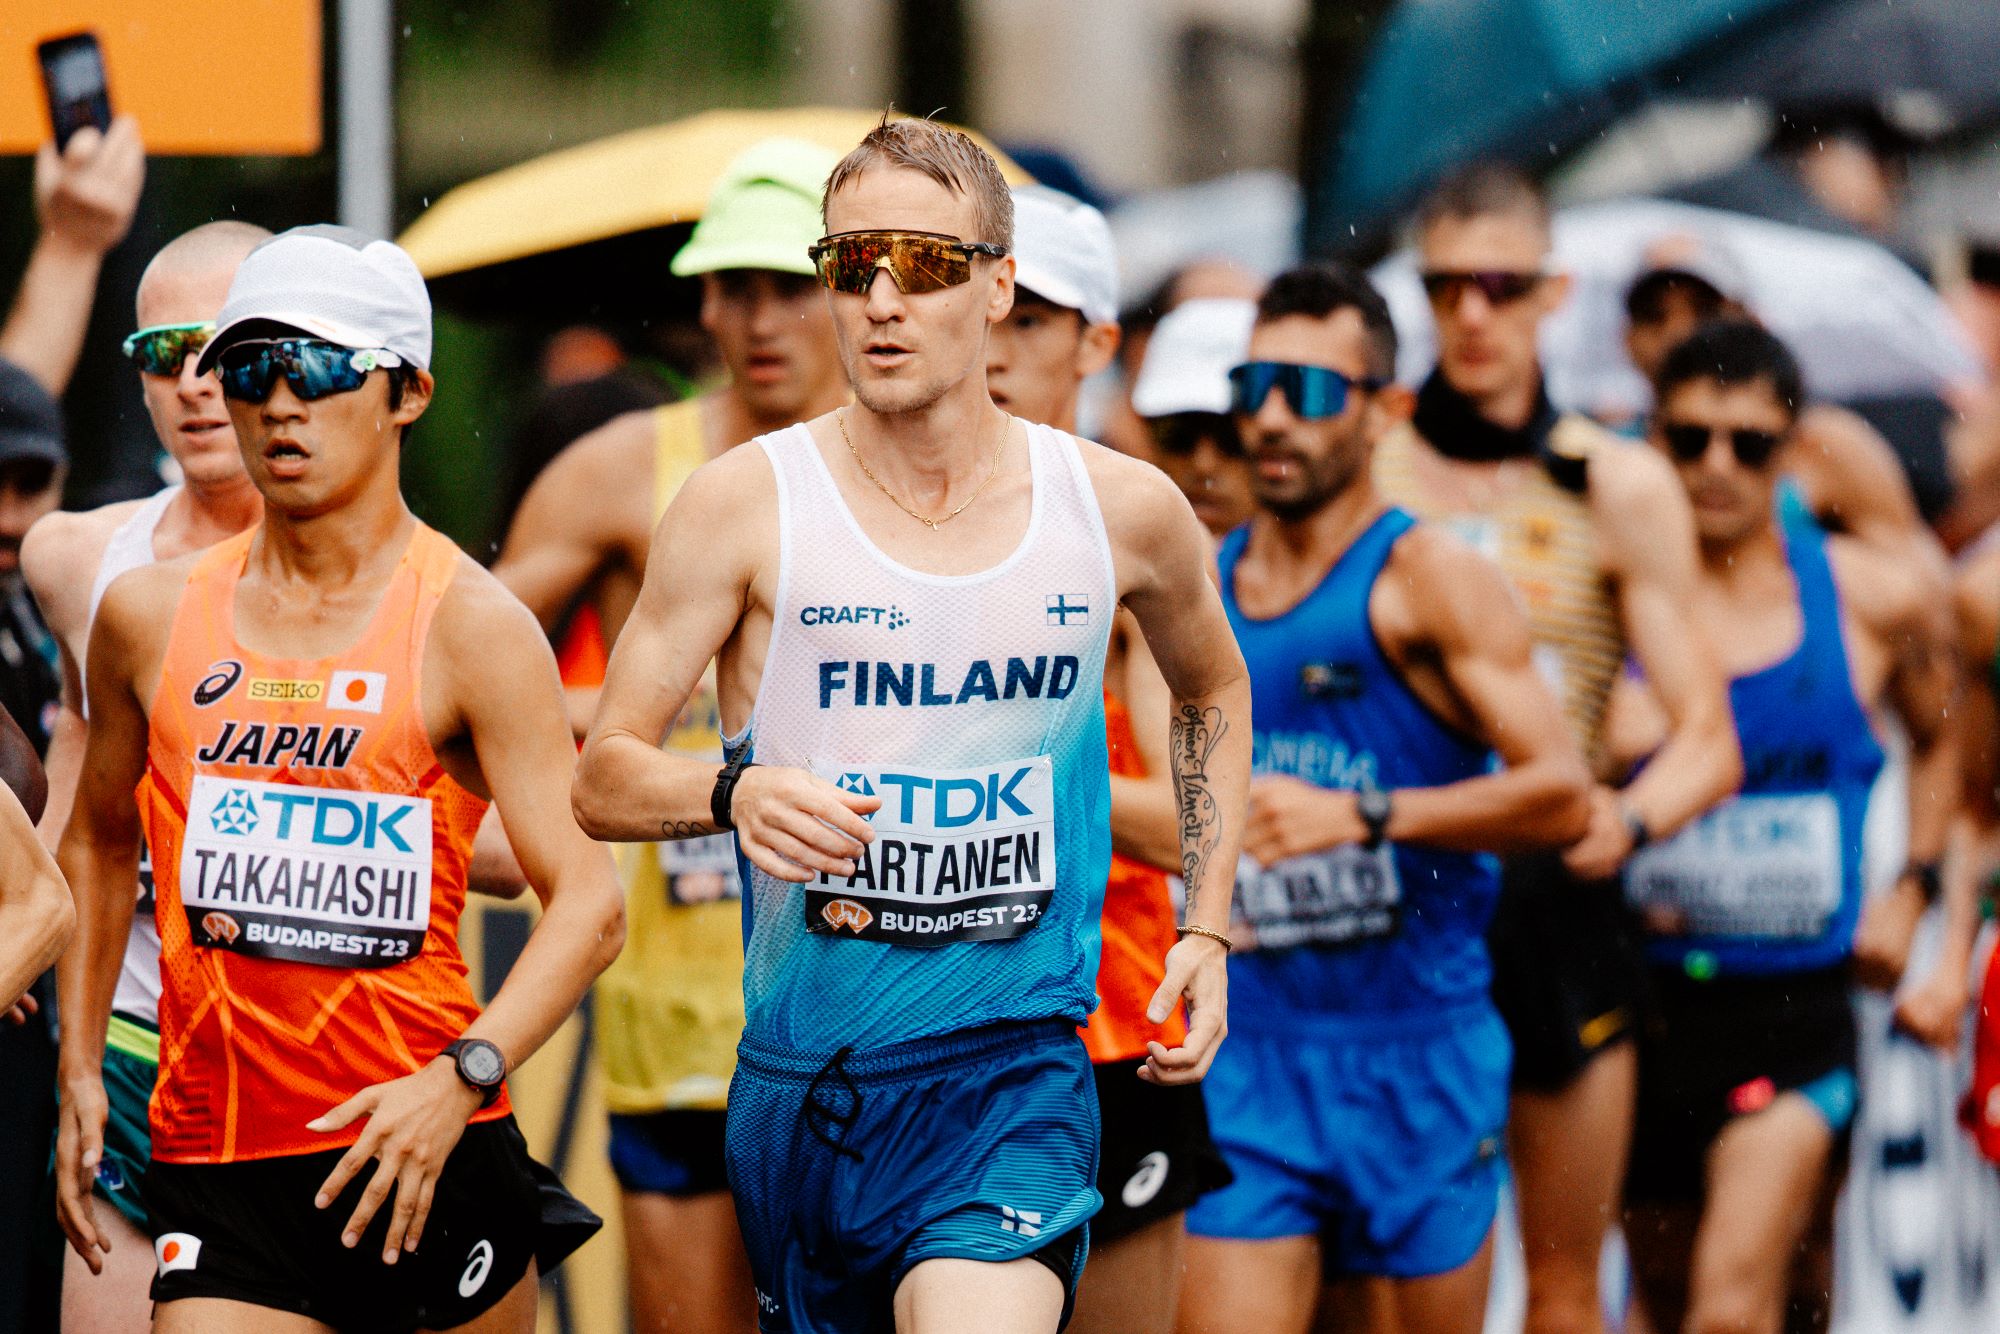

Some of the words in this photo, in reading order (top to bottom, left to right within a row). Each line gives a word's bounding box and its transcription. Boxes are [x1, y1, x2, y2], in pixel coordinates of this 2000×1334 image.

[800, 606, 886, 626] CRAFT
[251, 681, 320, 698] SEIKO
[819, 655, 1079, 708] FINLAND
[198, 721, 362, 768] JAPAN
[263, 791, 415, 853] TDK
[880, 766, 1034, 828] TDK
[195, 848, 417, 921] TAKAHASHI
[819, 831, 1041, 896] ARTANEN
[246, 921, 379, 957] BUDAPEST
[380, 938, 410, 957] 23
[880, 904, 1008, 934] BUDAPEST
[1011, 903, 1038, 923] 23
